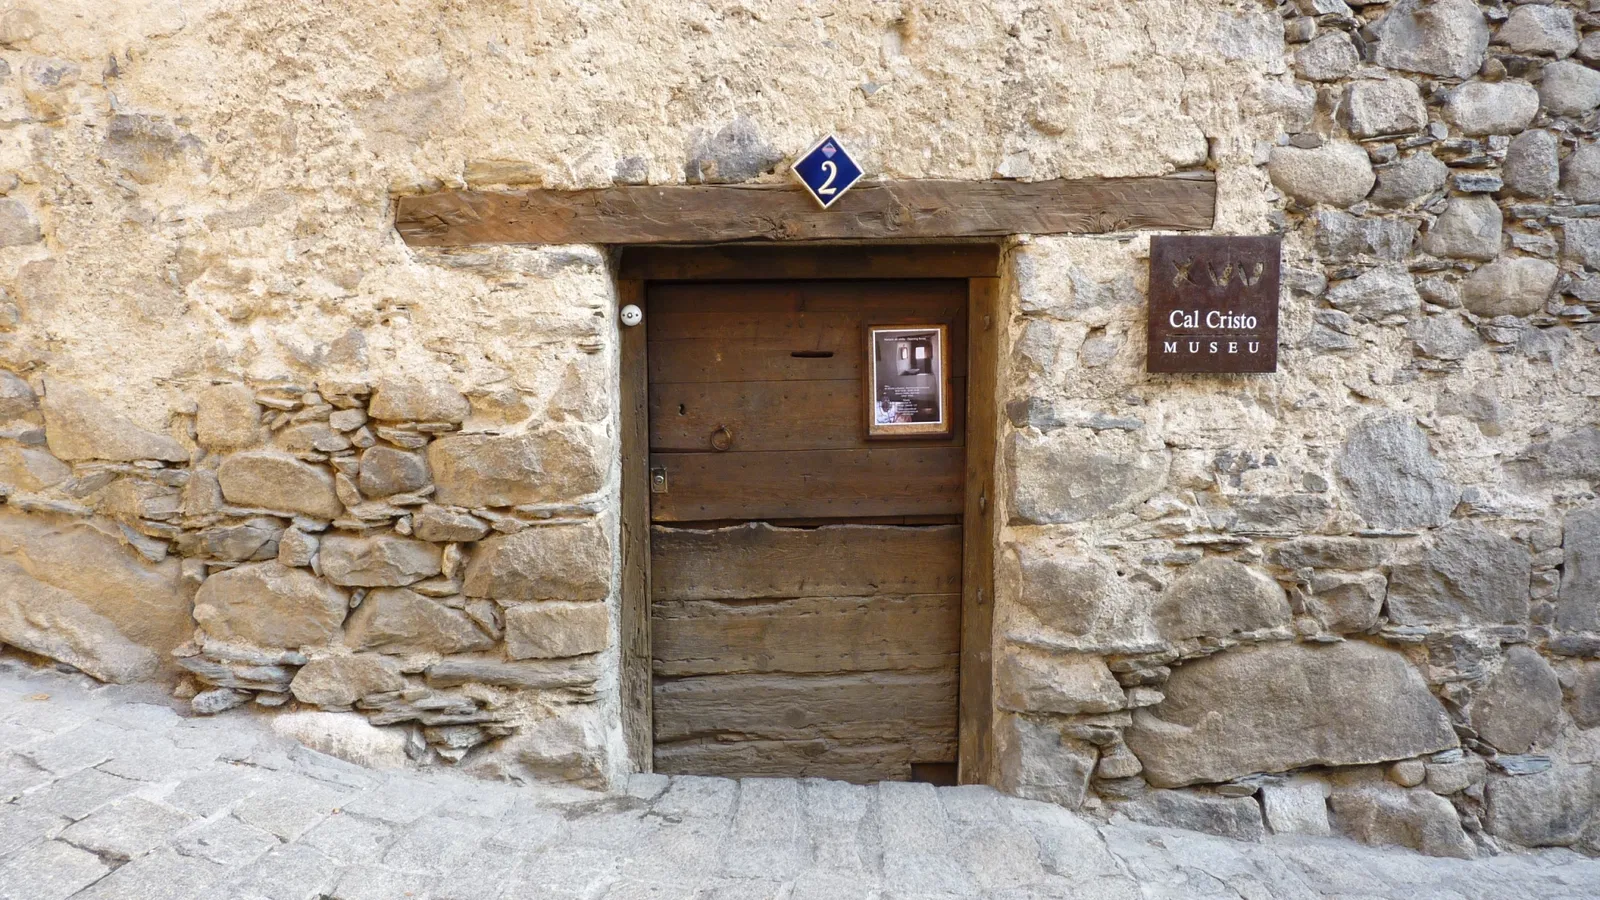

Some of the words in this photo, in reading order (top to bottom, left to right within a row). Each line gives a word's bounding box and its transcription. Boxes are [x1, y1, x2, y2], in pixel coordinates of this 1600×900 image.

[818, 160, 837, 195] 2
[1169, 310, 1199, 328] Cal
[1206, 310, 1257, 329] Cristo
[1164, 341, 1260, 354] MUSEU
